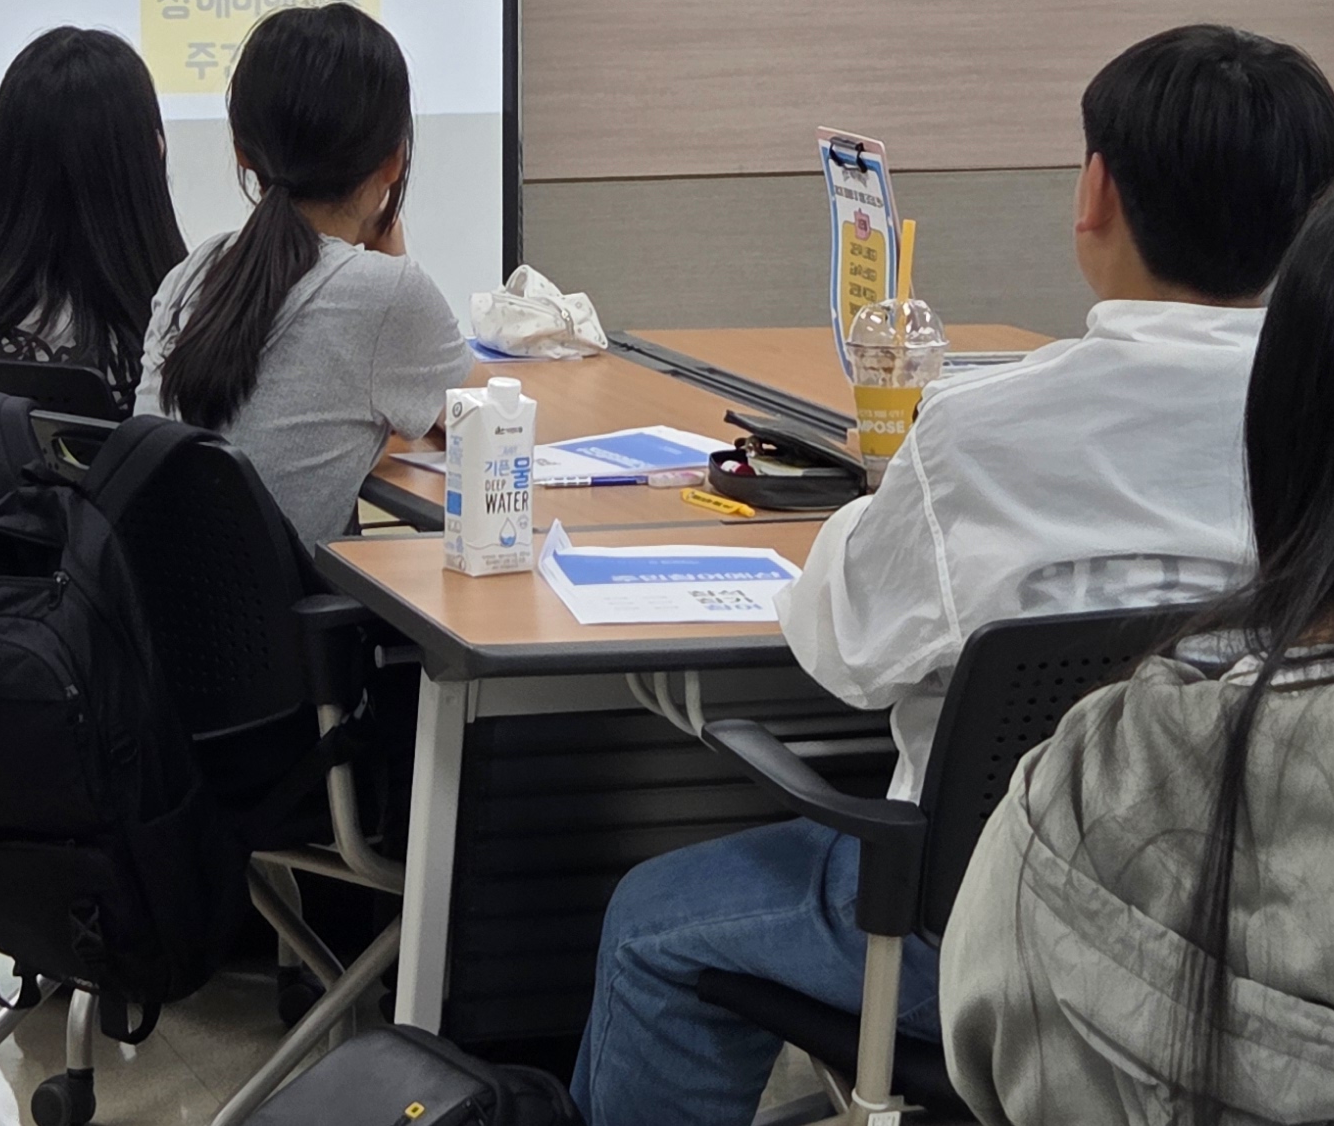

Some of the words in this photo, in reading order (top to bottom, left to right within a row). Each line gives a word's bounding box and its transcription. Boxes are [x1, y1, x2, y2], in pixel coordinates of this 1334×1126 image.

[485, 479, 507, 492] DEEP
[510, 456, 532, 490] 물
[485, 490, 530, 515] WATER
